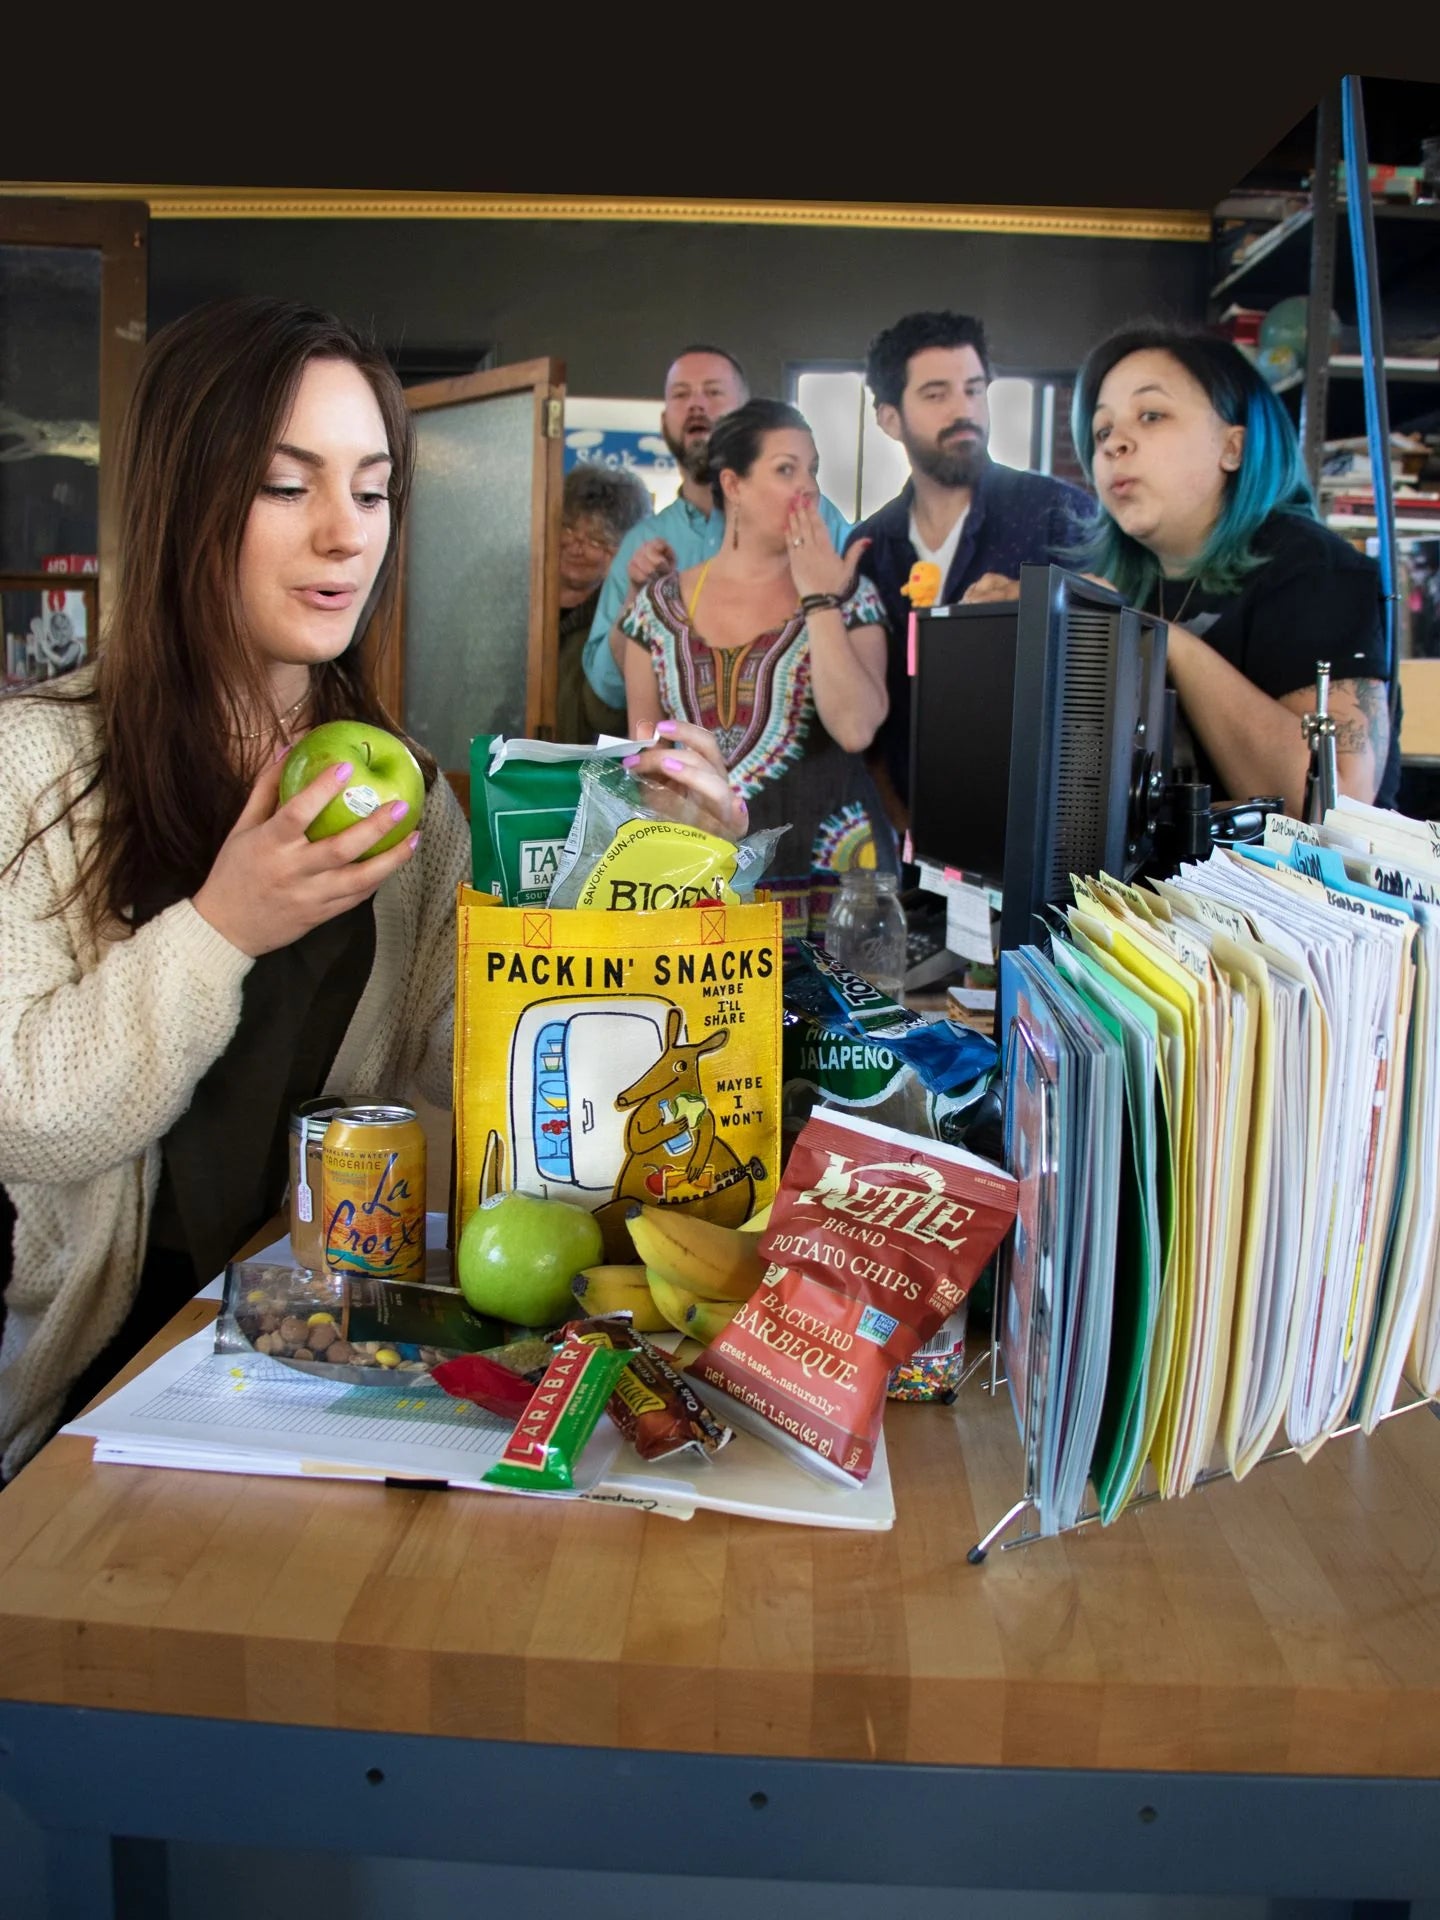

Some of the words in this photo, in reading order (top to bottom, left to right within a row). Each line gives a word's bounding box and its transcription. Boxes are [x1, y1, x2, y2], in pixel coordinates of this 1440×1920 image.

[583, 862, 609, 906] SAVORY
[487, 952, 634, 988] PACKIN'
[654, 949, 773, 986] SNACKS
[703, 983, 744, 998] MAYBE
[717, 1000, 741, 1012] I'LL
[704, 1012, 746, 1027] SHARE
[716, 1077, 763, 1093] MAYBE
[734, 1096, 742, 1109] I
[720, 1112, 764, 1128] WON'T
[362, 1152, 413, 1217] La
[792, 1150, 975, 1253] KETTLE
[325, 1199, 418, 1266] Croix
[821, 1217, 888, 1248] BRAND
[768, 1234, 846, 1270] POTATO
[850, 1254, 924, 1301] CHIPS
[936, 1278, 966, 1305] 220
[760, 1292, 854, 1352] BACKYARD
[719, 1341, 747, 1362] great
[733, 1303, 859, 1390] BARBEQUE
[704, 1366, 725, 1387] net
[726, 1377, 767, 1414] weight
